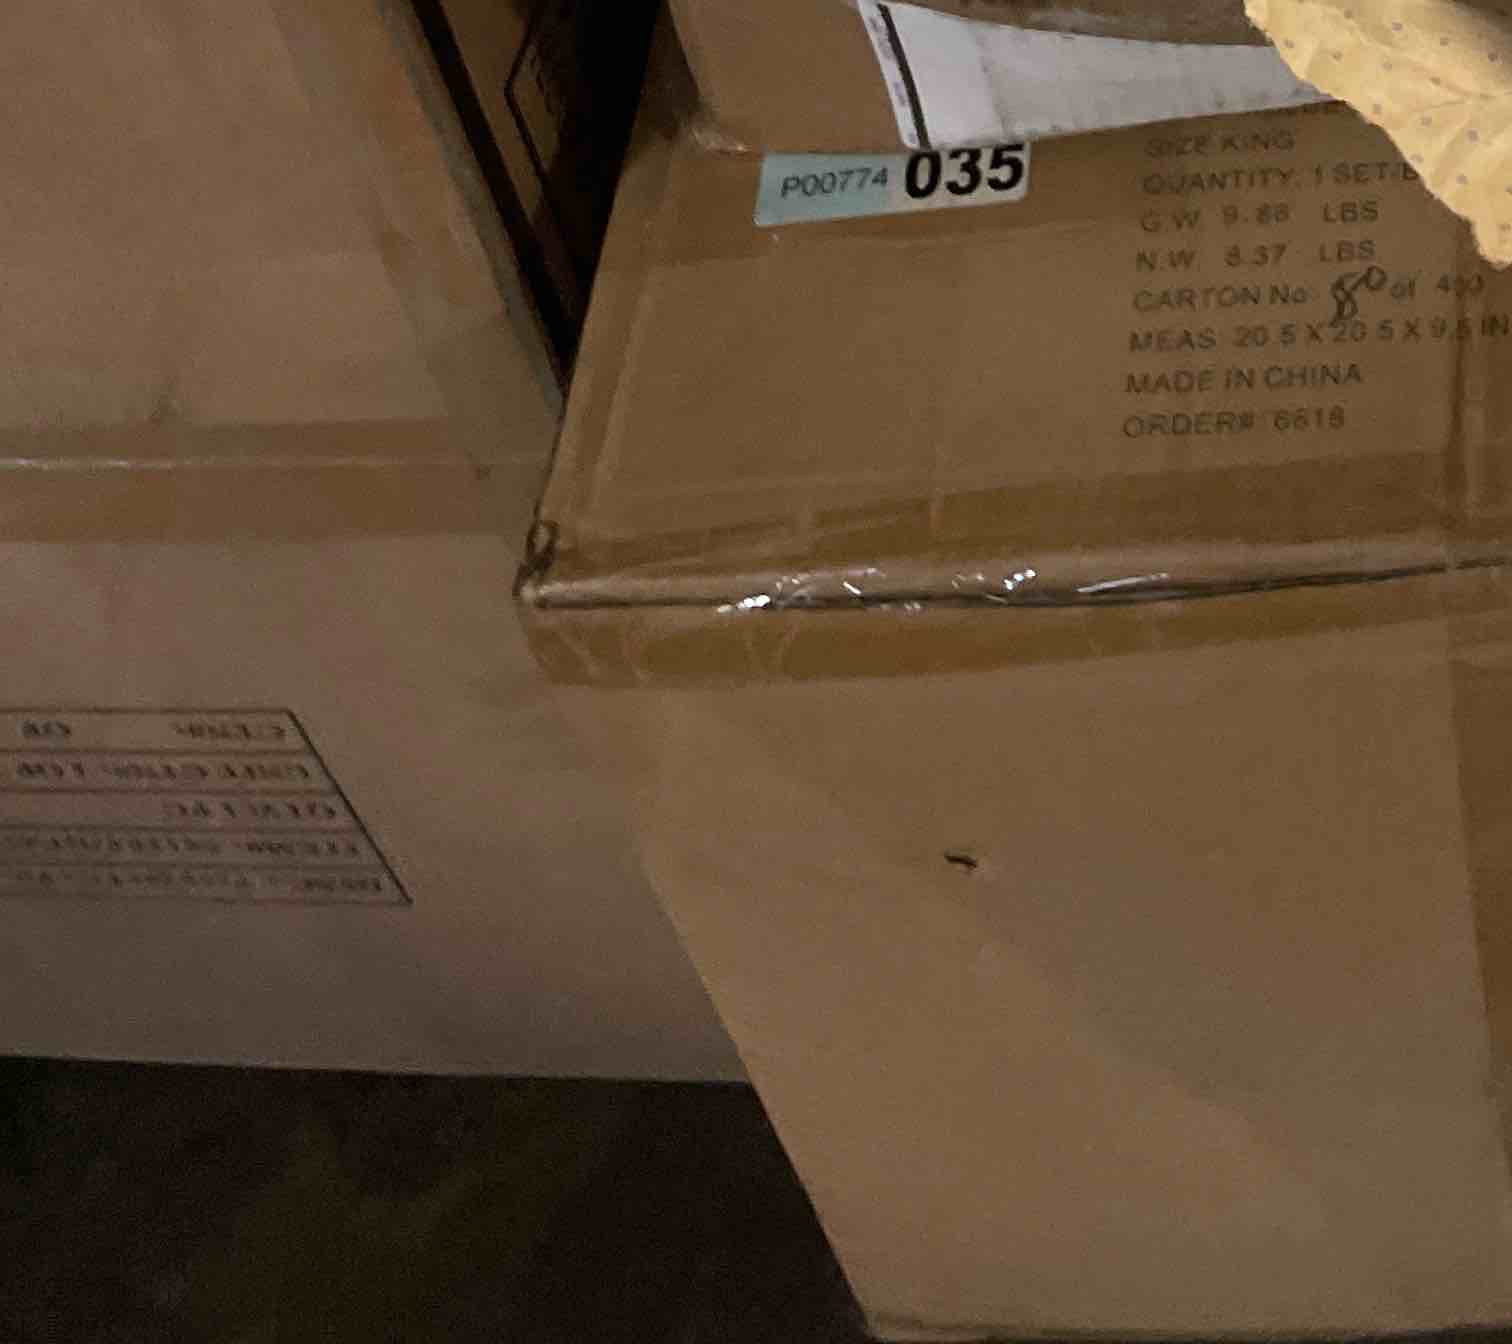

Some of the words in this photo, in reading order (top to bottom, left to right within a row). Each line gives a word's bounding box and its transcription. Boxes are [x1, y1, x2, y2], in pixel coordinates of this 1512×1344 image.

[1221, 130, 1296, 154] KING
[780, 167, 889, 201] P00774
[904, 143, 1025, 199] 035
[1133, 287, 1260, 312] CARTON
[1125, 369, 1215, 396] MADE
[1223, 368, 1256, 392] IN
[1263, 362, 1363, 391] CHINA
[1122, 411, 1256, 440] ORDER#
